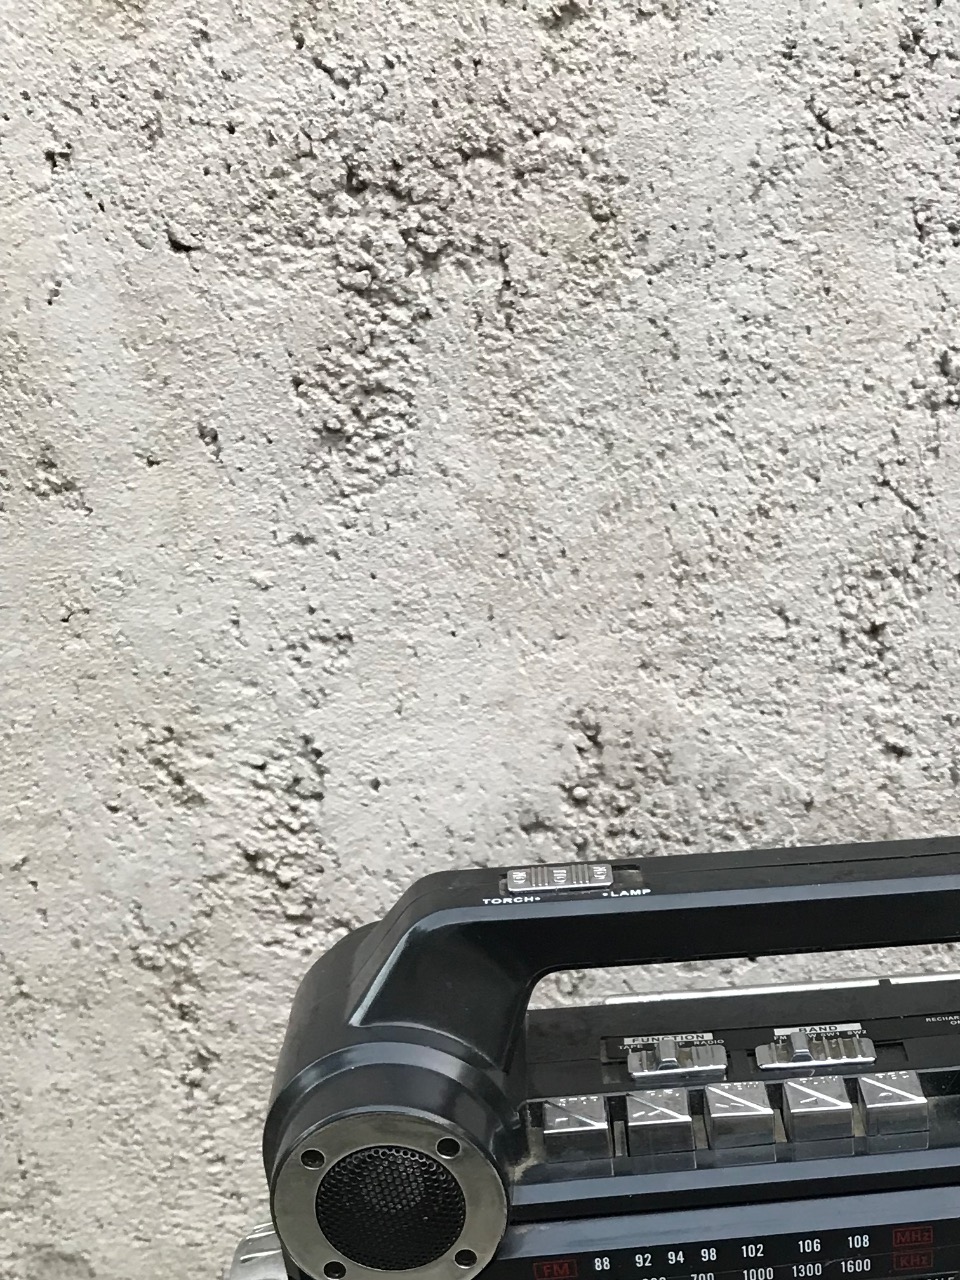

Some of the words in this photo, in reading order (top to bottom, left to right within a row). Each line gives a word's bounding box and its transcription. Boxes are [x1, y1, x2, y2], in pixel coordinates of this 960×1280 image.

[610, 888, 652, 898] LAMP
[482, 896, 534, 905] TORCH
[798, 1025, 838, 1033] BAND
[632, 1033, 705, 1044] FUNCTION
[543, 1262, 570, 1277] FM
[594, 1256, 611, 1271] 88
[635, 1253, 652, 1268] 92
[667, 1250, 685, 1265] 94
[701, 1247, 717, 1262] 98
[741, 1243, 764, 1258] 102
[798, 1238, 821, 1253] 106
[847, 1234, 870, 1249] 108
[897, 1230, 931, 1243] MHz
[792, 1263, 822, 1278] 1300
[840, 1258, 871, 1273] 1600
[900, 1254, 930, 1267] KHz
